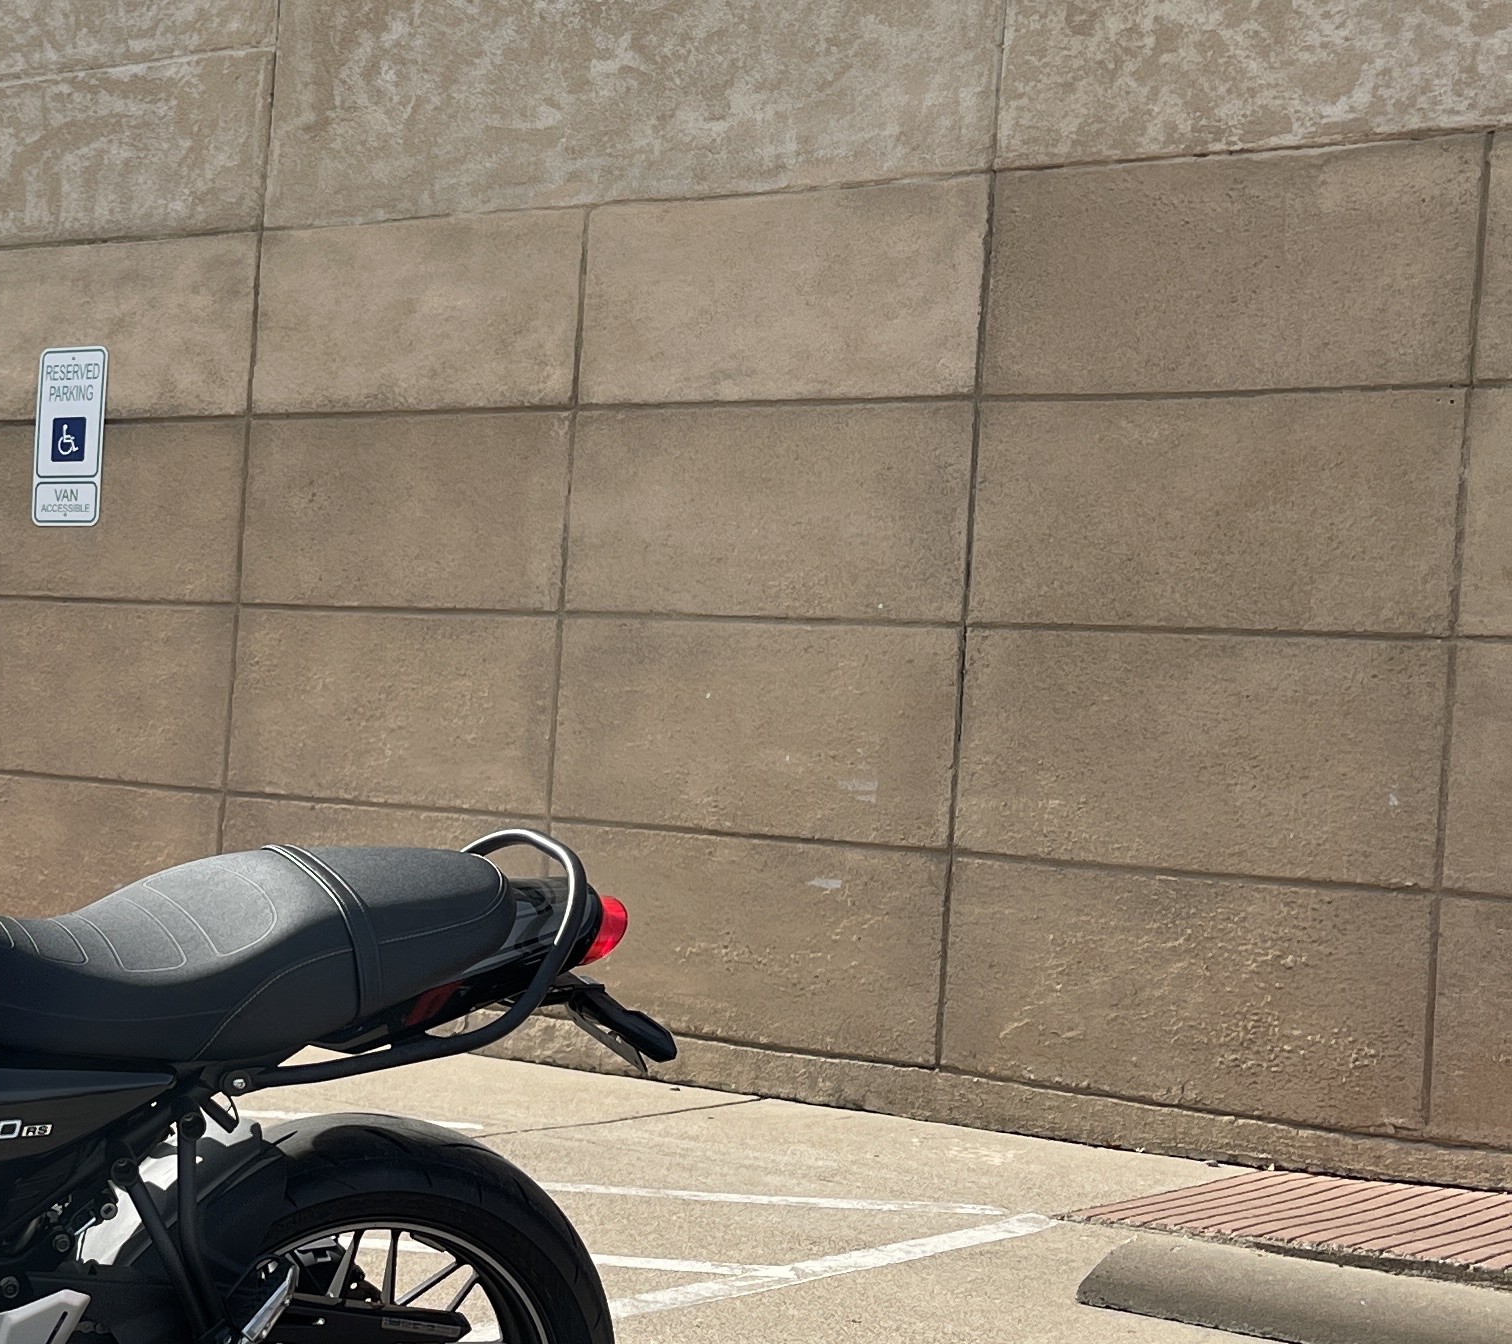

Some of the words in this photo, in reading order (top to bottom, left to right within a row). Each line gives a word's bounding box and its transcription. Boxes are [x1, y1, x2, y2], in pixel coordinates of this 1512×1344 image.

[46, 362, 100, 381] RESERVED
[48, 384, 94, 402] PARKING
[53, 488, 79, 502] VAN
[40, 503, 90, 513] ACCESSIBLE
